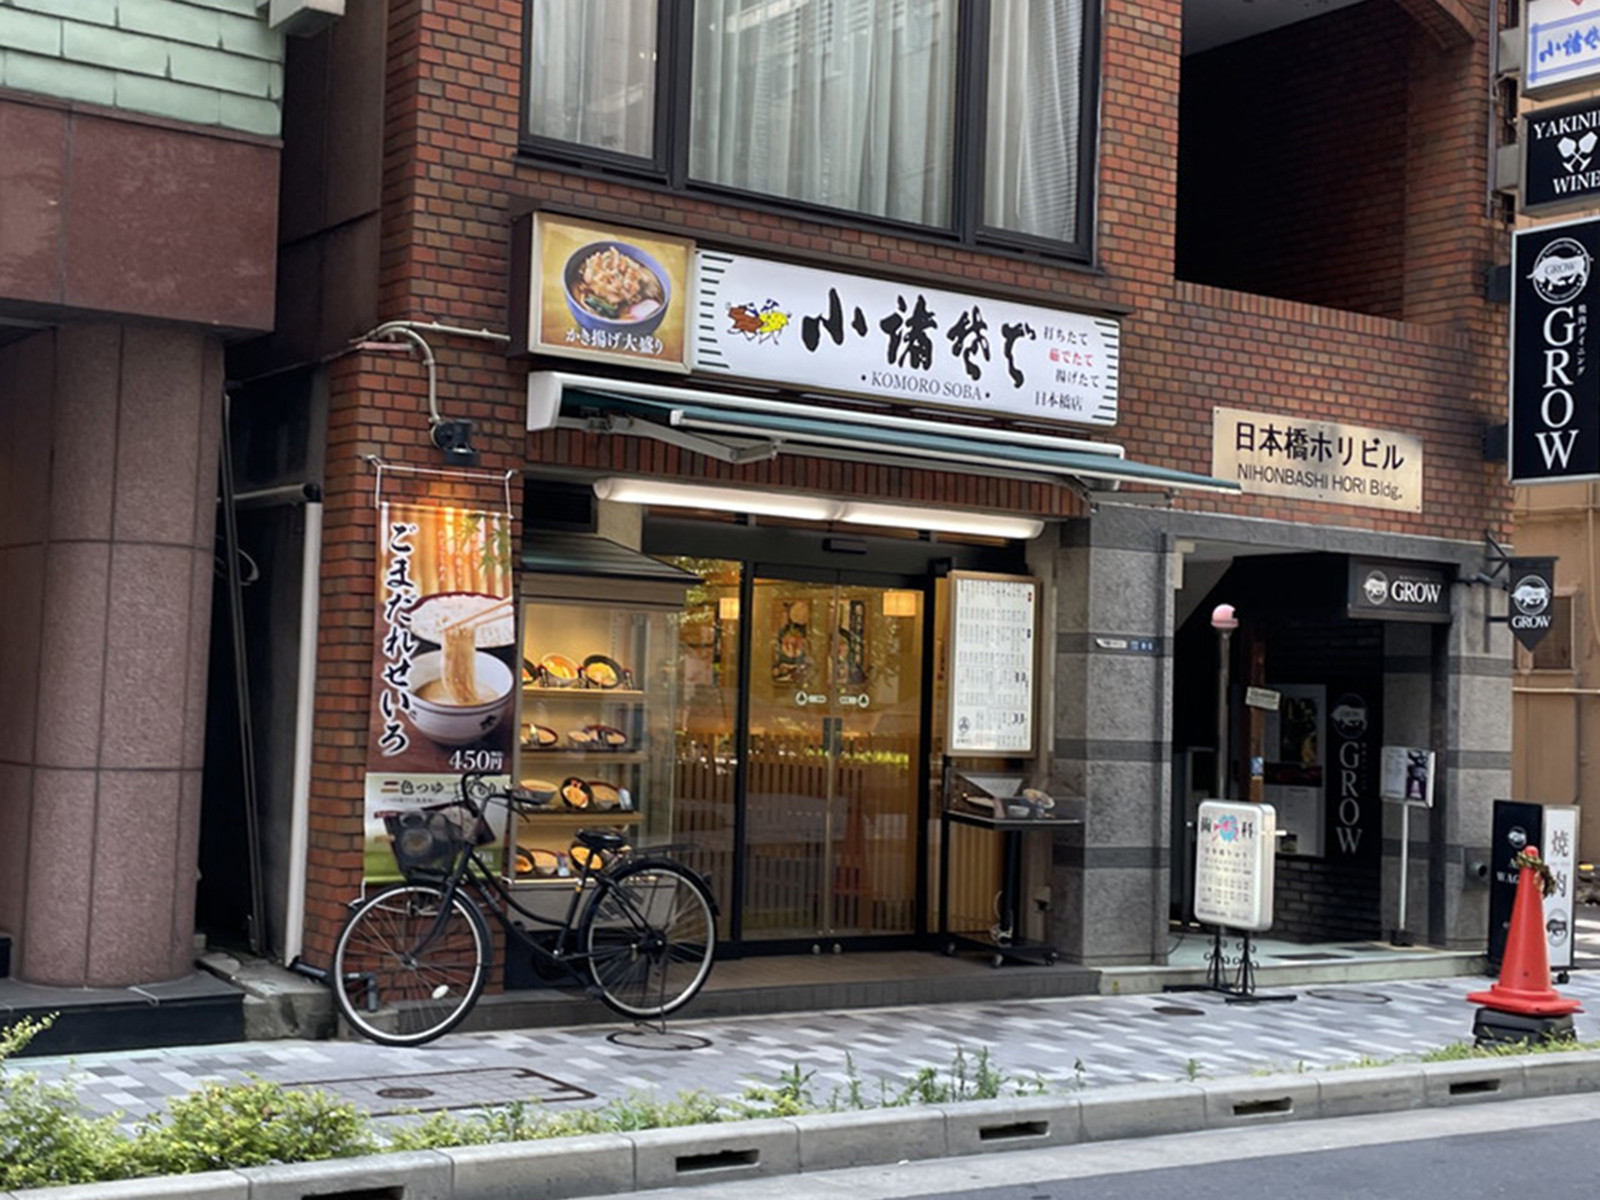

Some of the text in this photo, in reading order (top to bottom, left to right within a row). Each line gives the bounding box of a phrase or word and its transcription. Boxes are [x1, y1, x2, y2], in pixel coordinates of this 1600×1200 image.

[1533, 110, 1600, 140] YAKINI
[1552, 171, 1600, 195] WINE
[565, 328, 663, 354] かき揚げ大盛り
[1044, 326, 1088, 346] 打ちたて
[871, 371, 982, 400] KOMORO SOBA
[1535, 306, 1580, 470] GROW
[1035, 390, 1082, 411] 日本橋店
[1236, 421, 1404, 470] 日本橋ホリビル
[1237, 463, 1403, 500] NIHONBASHI HORI Bldg.
[1391, 580, 1441, 603] GROW
[1512, 615, 1550, 628] GROW
[379, 523, 418, 755] ごまだれせいろ
[1337, 741, 1363, 855] GROW
